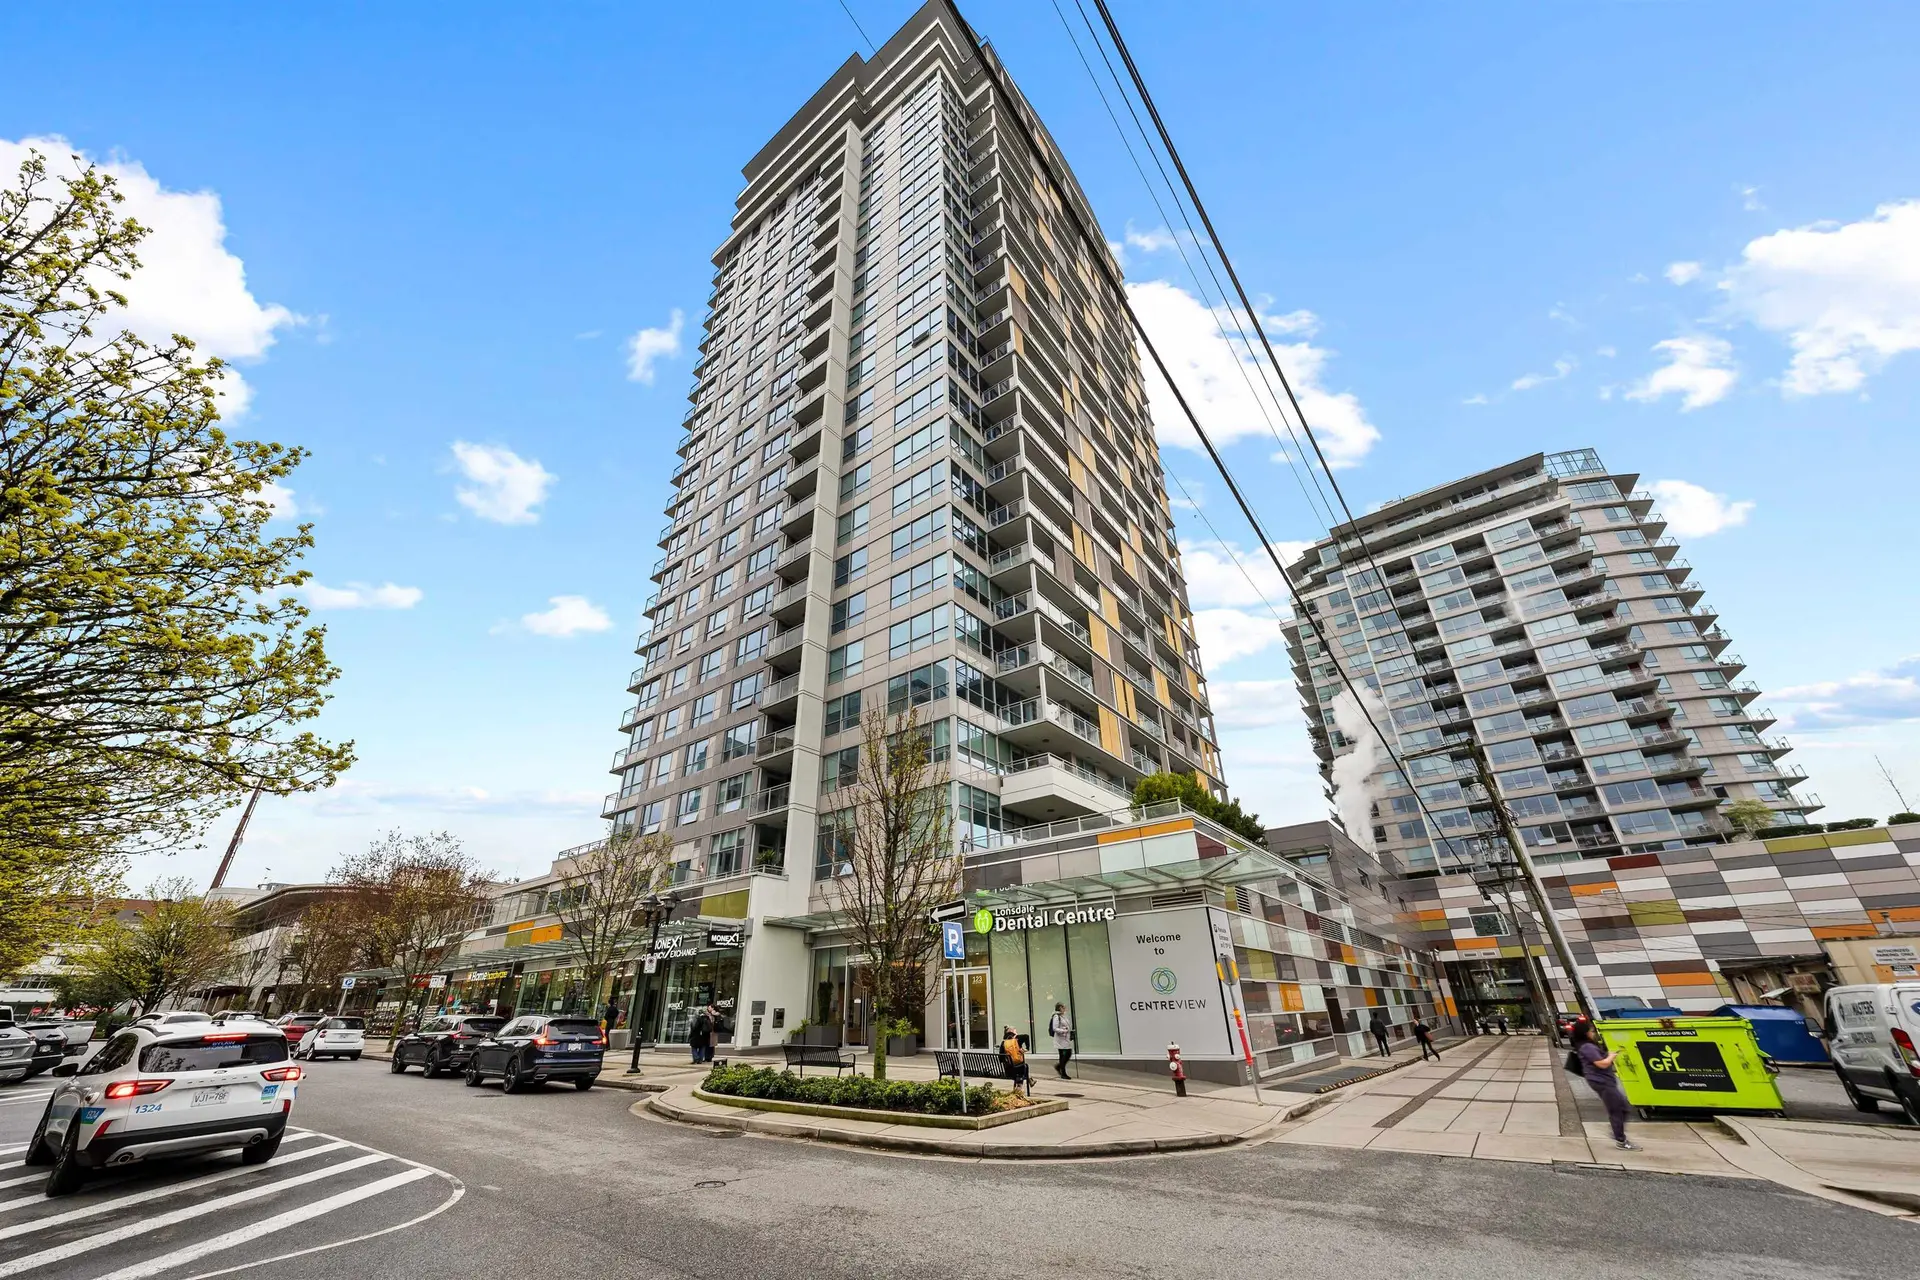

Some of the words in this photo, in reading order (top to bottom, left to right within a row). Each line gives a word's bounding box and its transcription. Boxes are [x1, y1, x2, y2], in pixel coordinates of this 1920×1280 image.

[995, 905, 1035, 917] Lonsdale
[995, 911, 1049, 932] Dental
[1054, 906, 1115, 926] Centre
[654, 936, 682, 951] ONEX1
[949, 928, 958, 951] P
[1136, 933, 1181, 944] Welcome
[670, 948, 697, 958] EXCHANGE
[1154, 947, 1165, 955] to
[471, 971, 488, 981] Home
[1130, 999, 1206, 1011] CENTREVIEW
[1649, 1050, 1686, 1071] GFL
[135, 1104, 162, 1113] 1324
